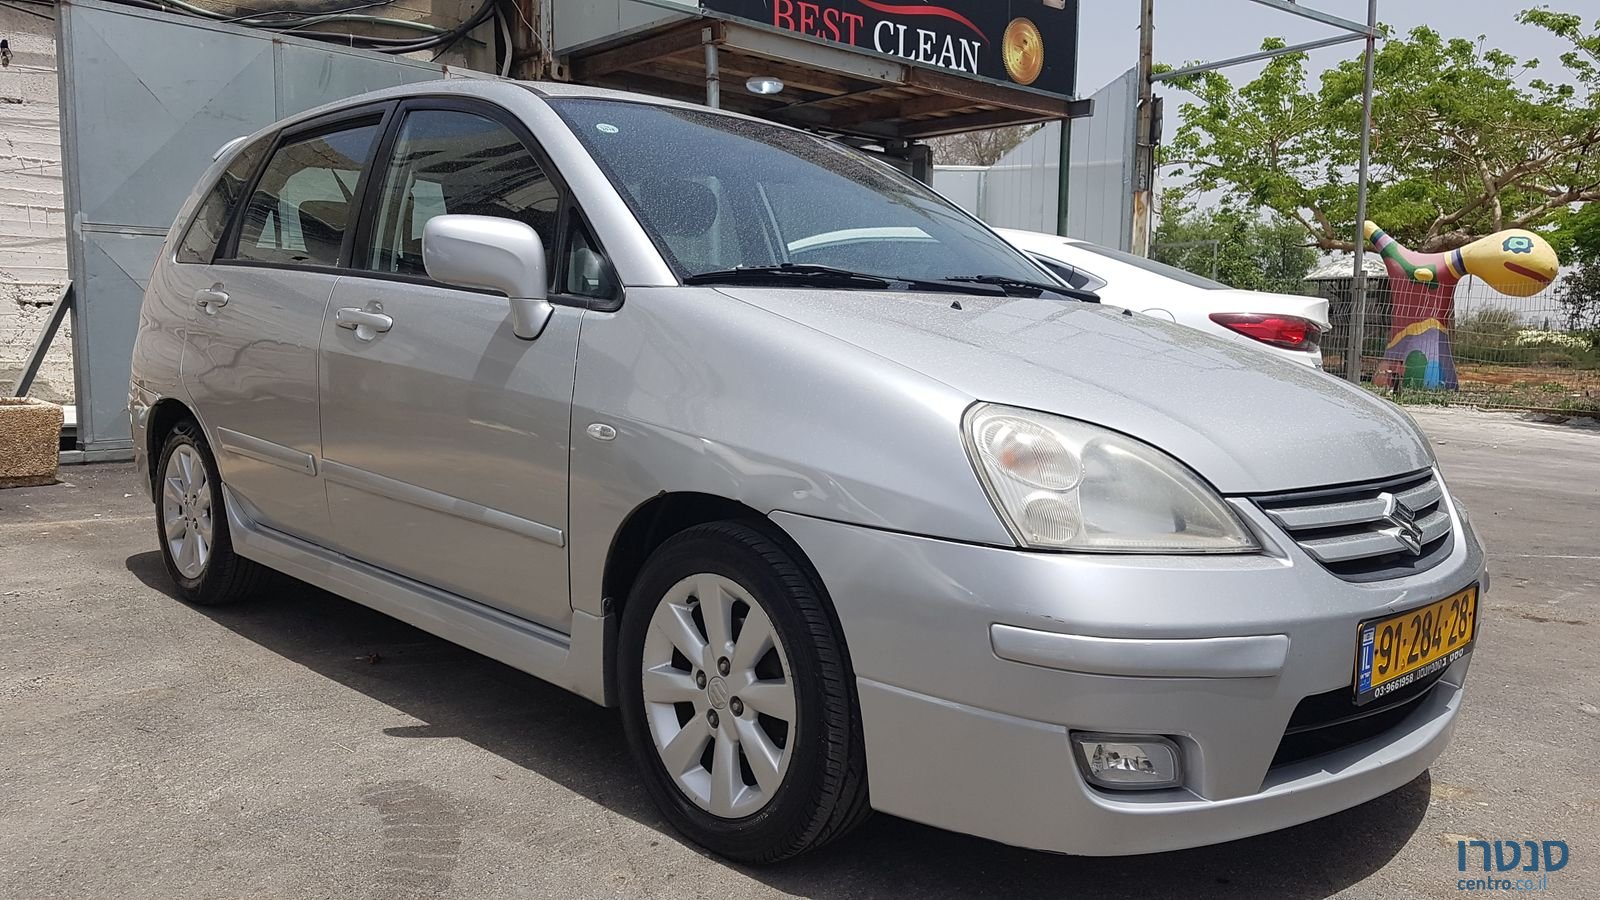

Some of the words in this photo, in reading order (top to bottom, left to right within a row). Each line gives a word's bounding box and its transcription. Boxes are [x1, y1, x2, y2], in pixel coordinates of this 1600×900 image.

[774, 0, 863, 47] BEST
[874, 20, 981, 75] CLEAN
[1362, 646, 1370, 670] IL
[1375, 673, 1413, 697] 03-9661958
